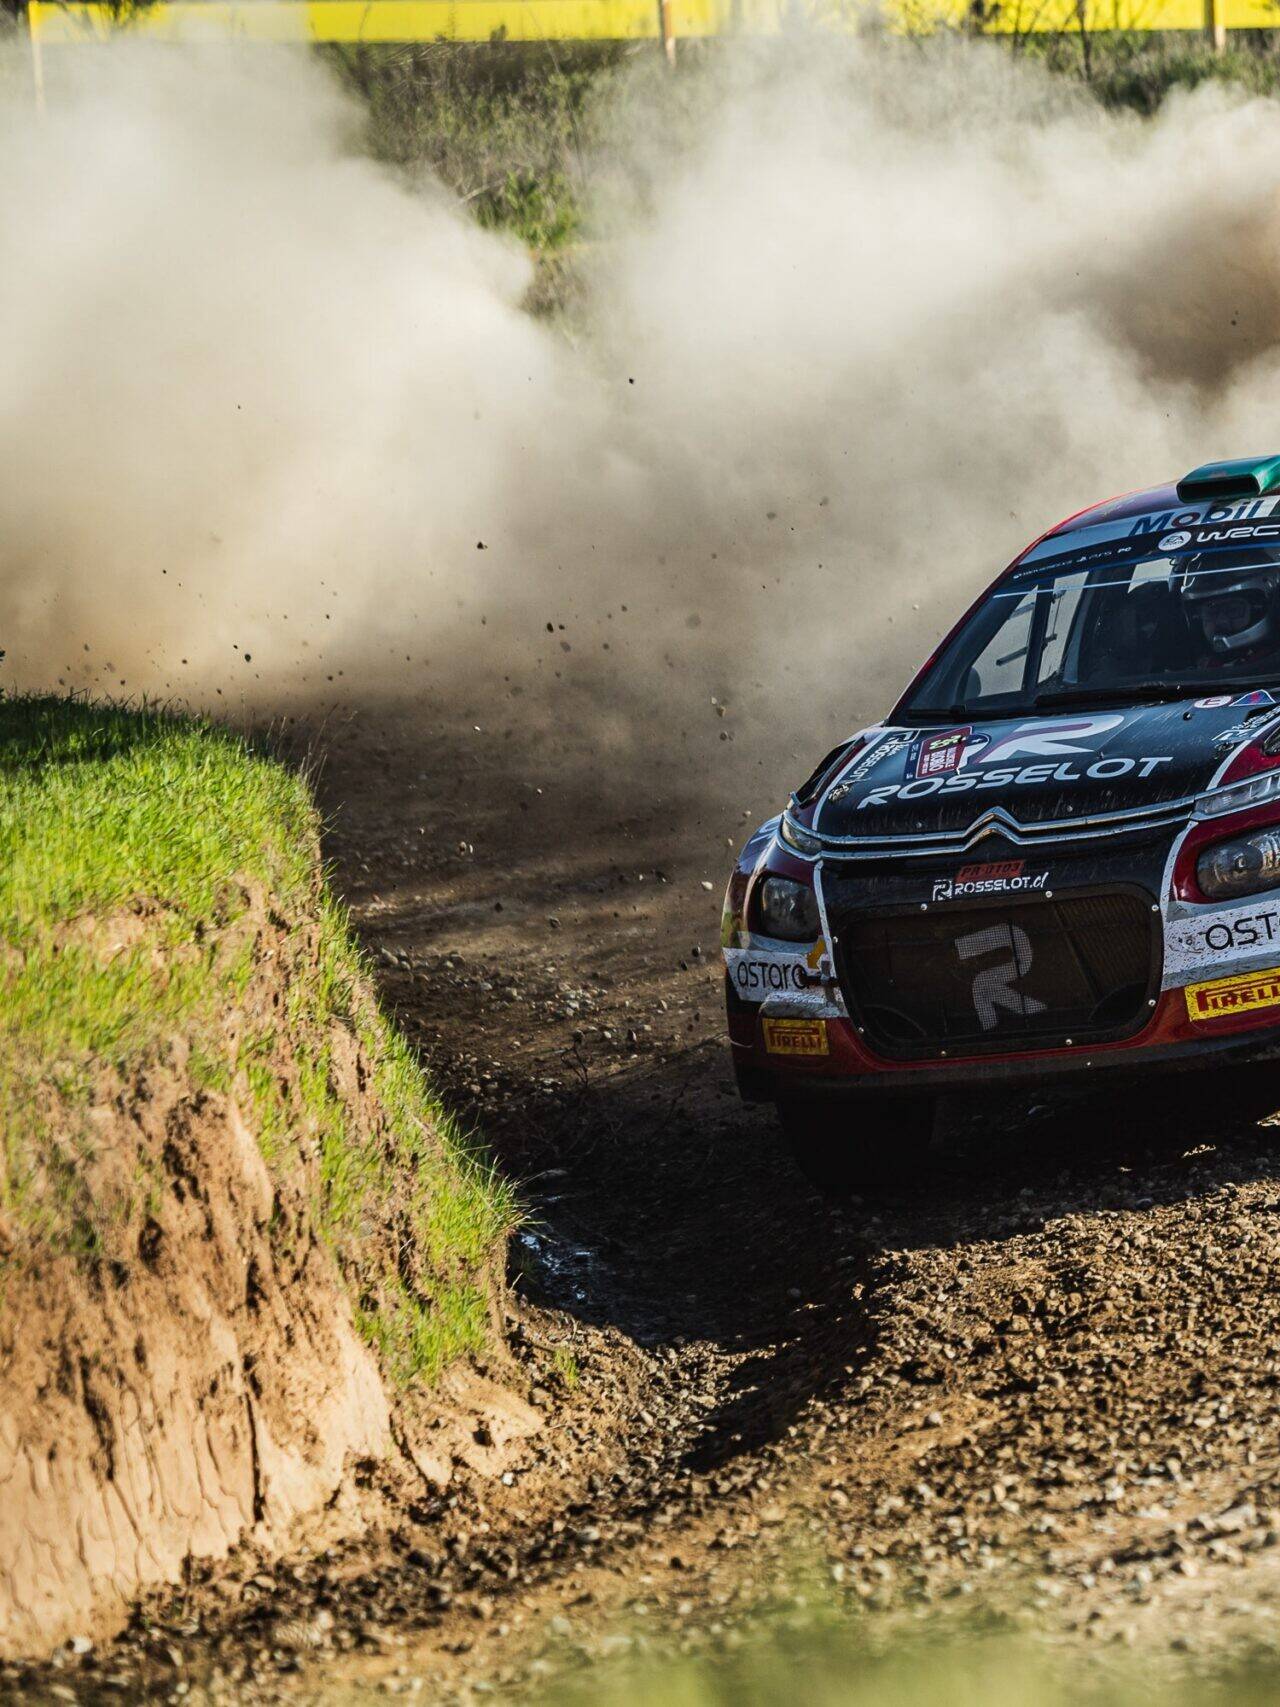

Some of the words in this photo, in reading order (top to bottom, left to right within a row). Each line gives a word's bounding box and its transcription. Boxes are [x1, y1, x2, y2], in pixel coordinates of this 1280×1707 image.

[1129, 499, 1267, 537] Mobil
[857, 756, 1175, 810] ROSSELOT
[768, 1026, 821, 1049] PIRELLI
